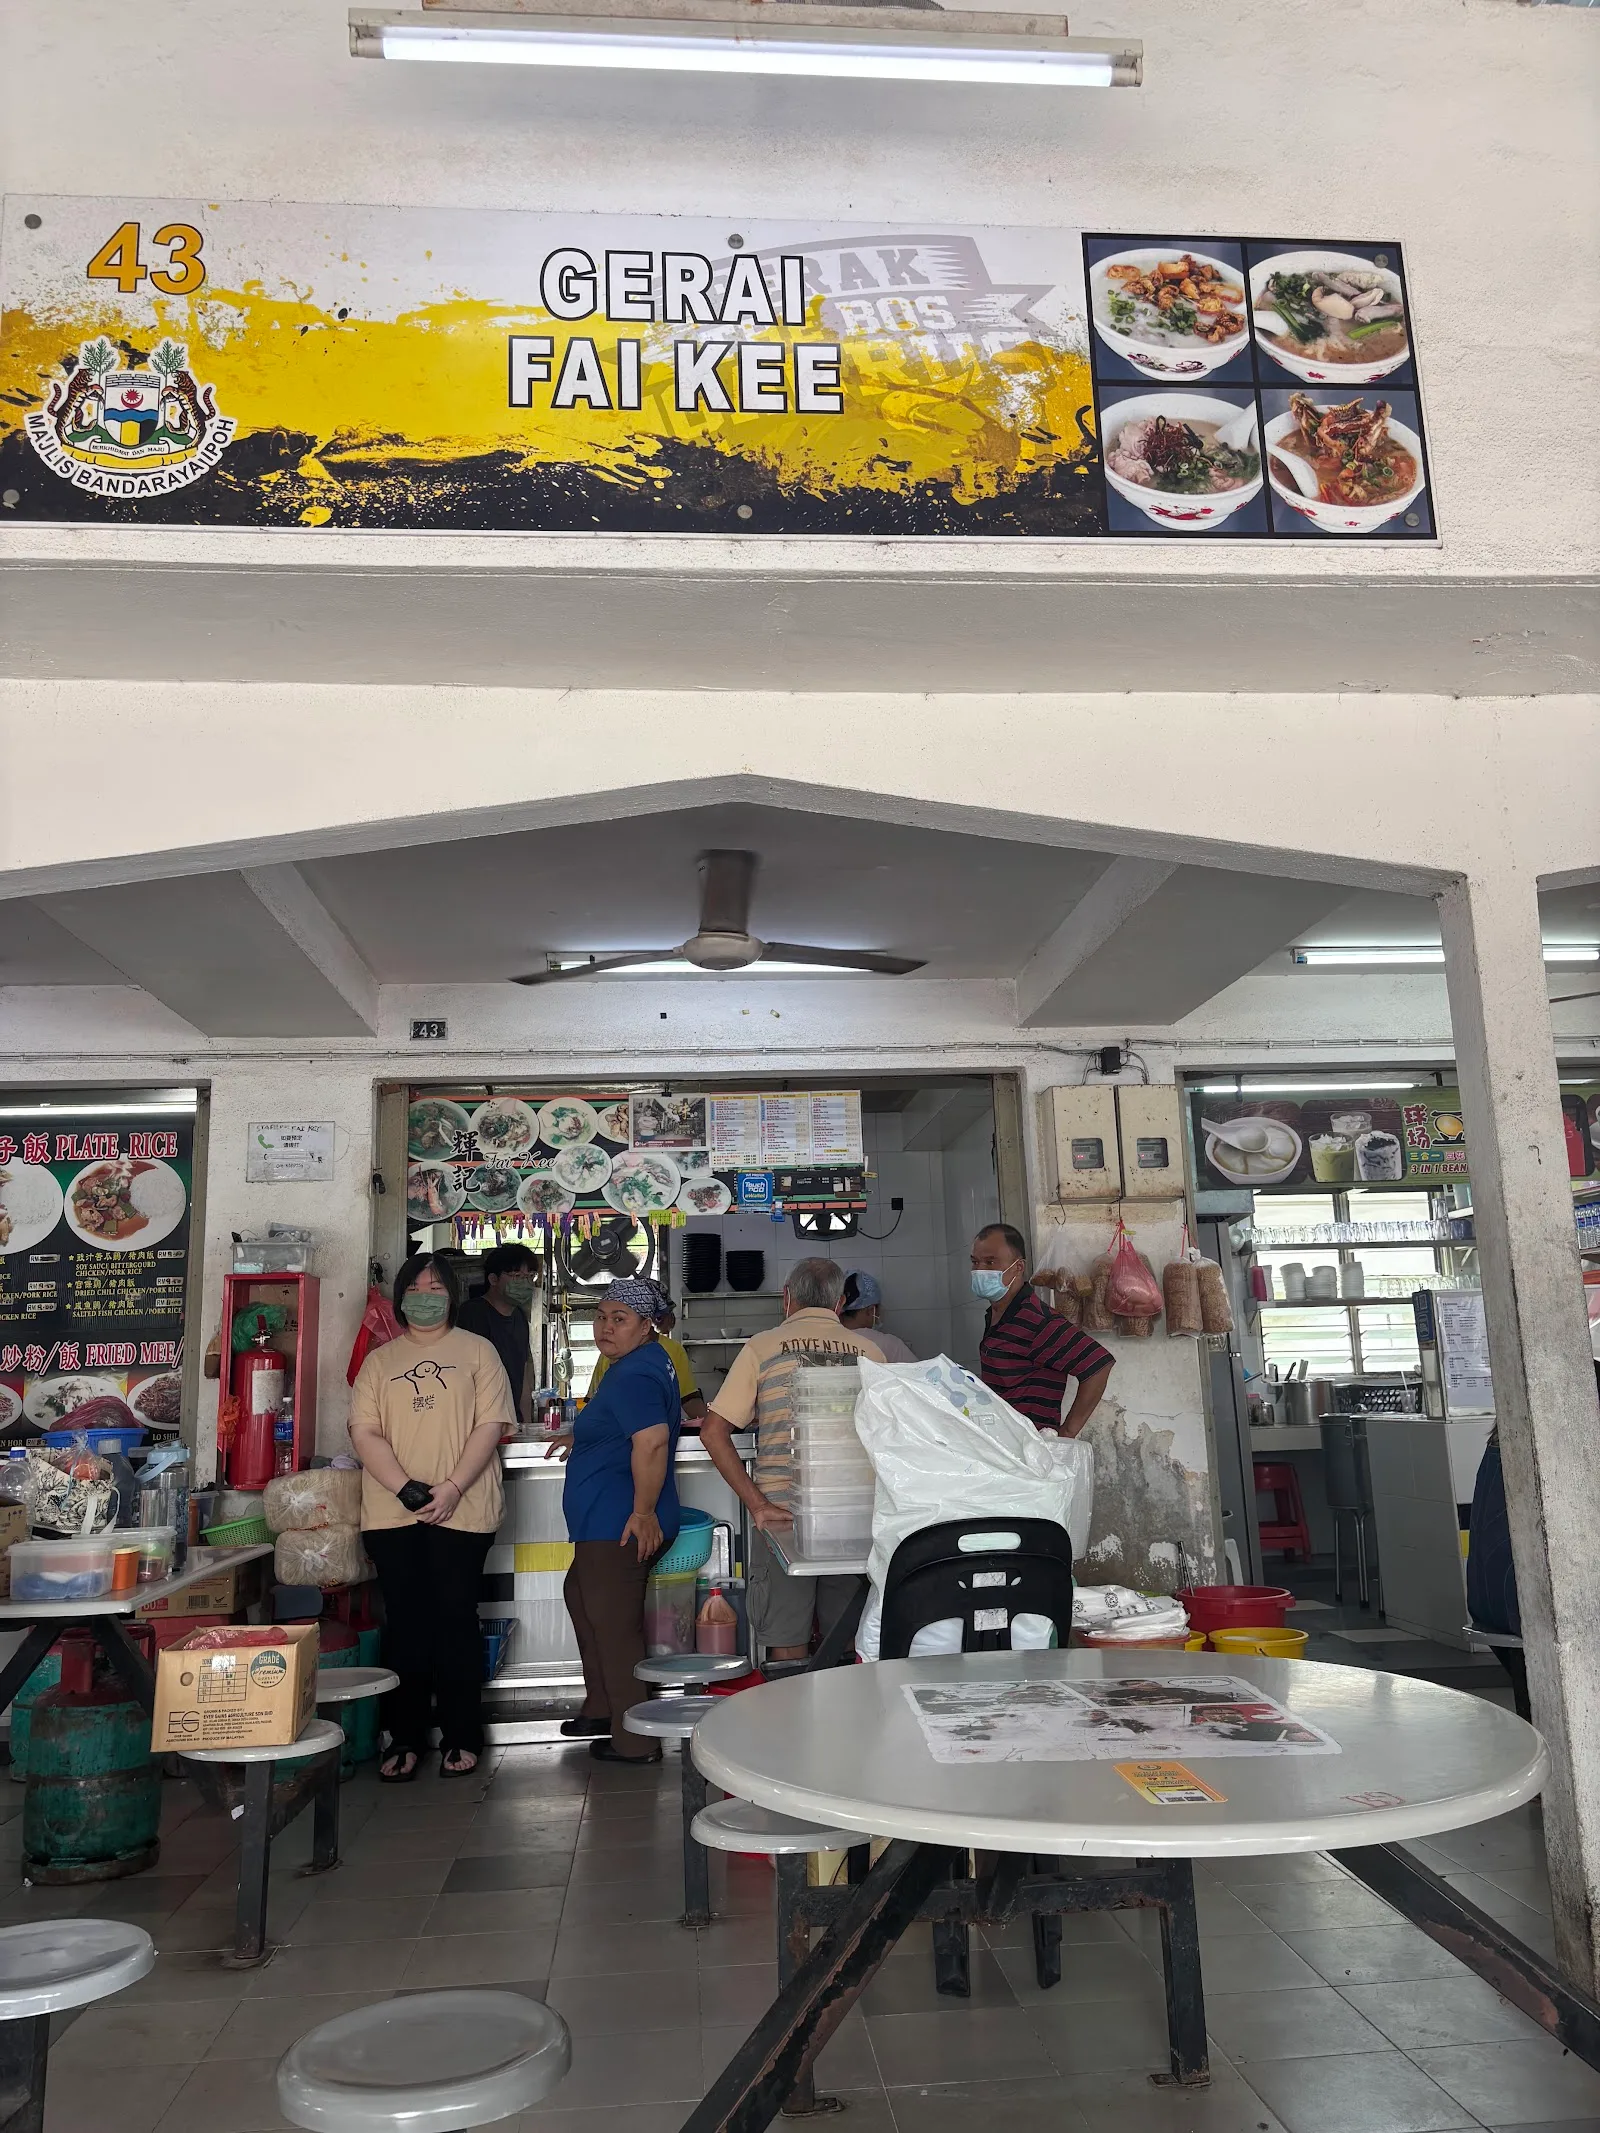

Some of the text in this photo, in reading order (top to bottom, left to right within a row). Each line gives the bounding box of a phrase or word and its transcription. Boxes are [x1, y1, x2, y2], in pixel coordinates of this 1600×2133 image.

[87, 222, 206, 295] 43
[539, 247, 806, 327] GERAI
[508, 335, 844, 415] FAI KEE
[27, 414, 234, 495] MAJLIS BANDARAYA IPOH
[418, 1023, 439, 1038] 43
[56, 1133, 119, 1160] PLATE
[129, 1131, 178, 1158] RICE
[483, 1150, 558, 1170] Fai Kee
[1409, 1152, 1441, 1160] 三合一
[1411, 1163, 1468, 1174] 3 IN 1 BEAN
[76, 1268, 125, 1277] CHICKEN/PORK
[117, 1287, 167, 1295] CHICKEN/PORK
[73, 1310, 97, 1318] SALTED
[85, 1342, 137, 1366] FRIED
[258, 1654, 280, 1665] GRADE
[252, 1667, 284, 1675] Premium
[168, 1711, 200, 1734] EG
